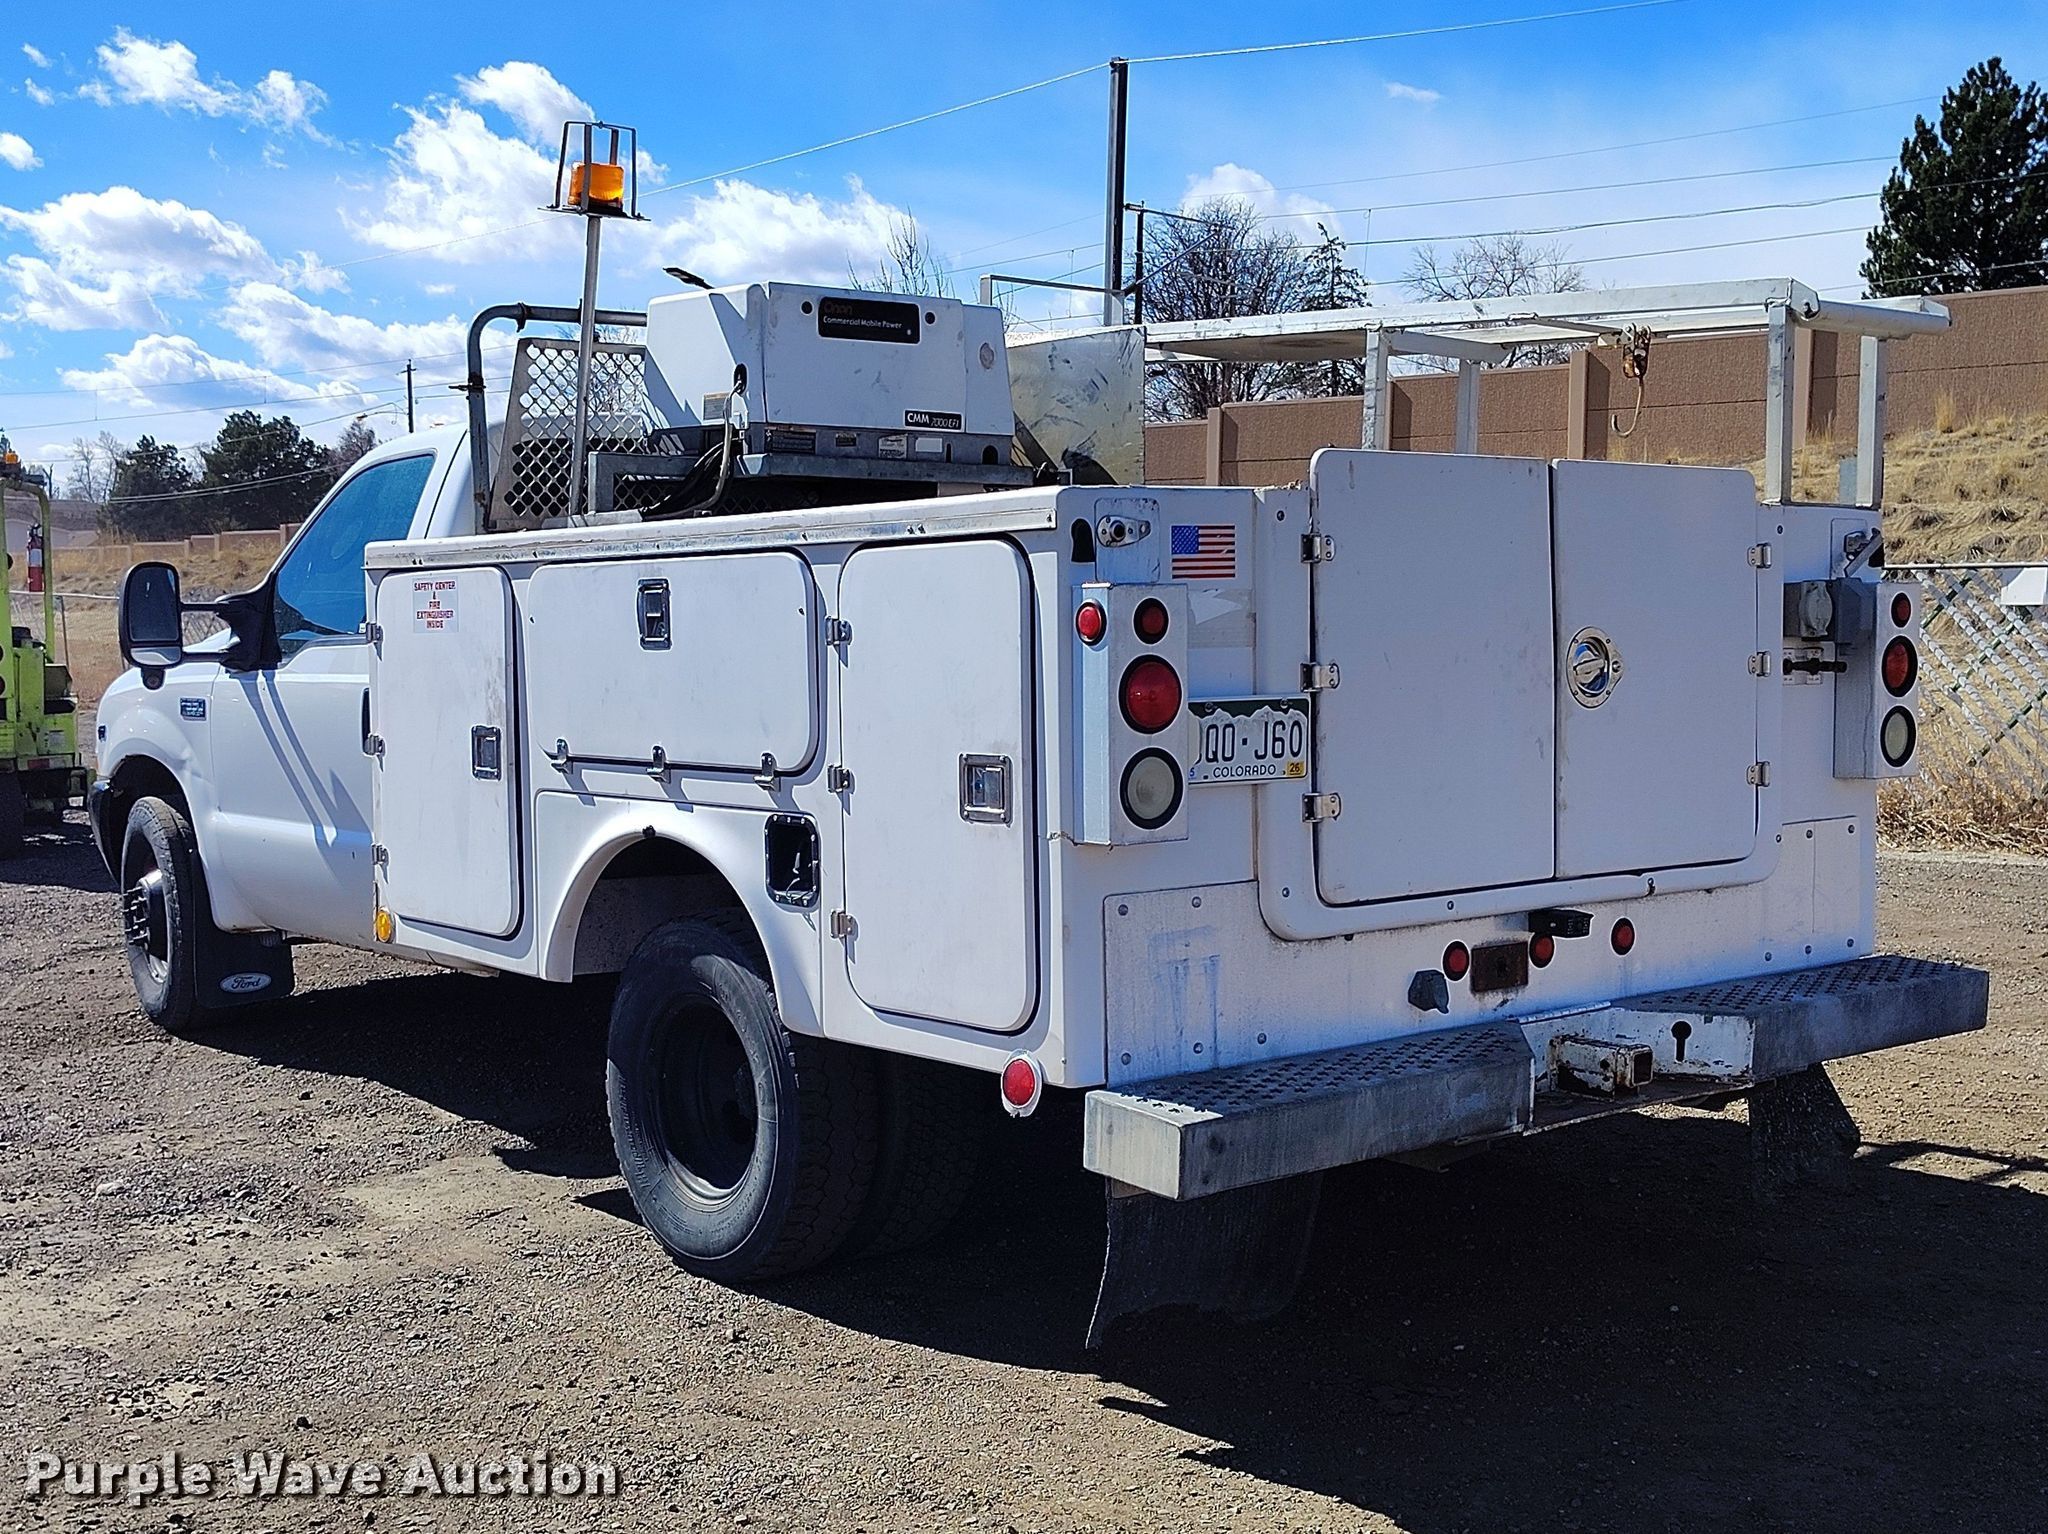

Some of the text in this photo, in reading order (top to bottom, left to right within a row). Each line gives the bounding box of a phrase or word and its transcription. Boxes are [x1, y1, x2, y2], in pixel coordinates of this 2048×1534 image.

[823, 315, 903, 329] Commercial Mobile Power
[907, 412, 930, 424] CMM
[414, 581, 456, 591] SAFETY CENTER
[429, 601, 441, 610] FIRE
[416, 610, 454, 619] EXTINGUISHER
[426, 620, 444, 629] INSIDE
[1213, 764, 1276, 778] COLORADO
[1289, 762, 1301, 774] 26
[231, 975, 261, 990] Ford
